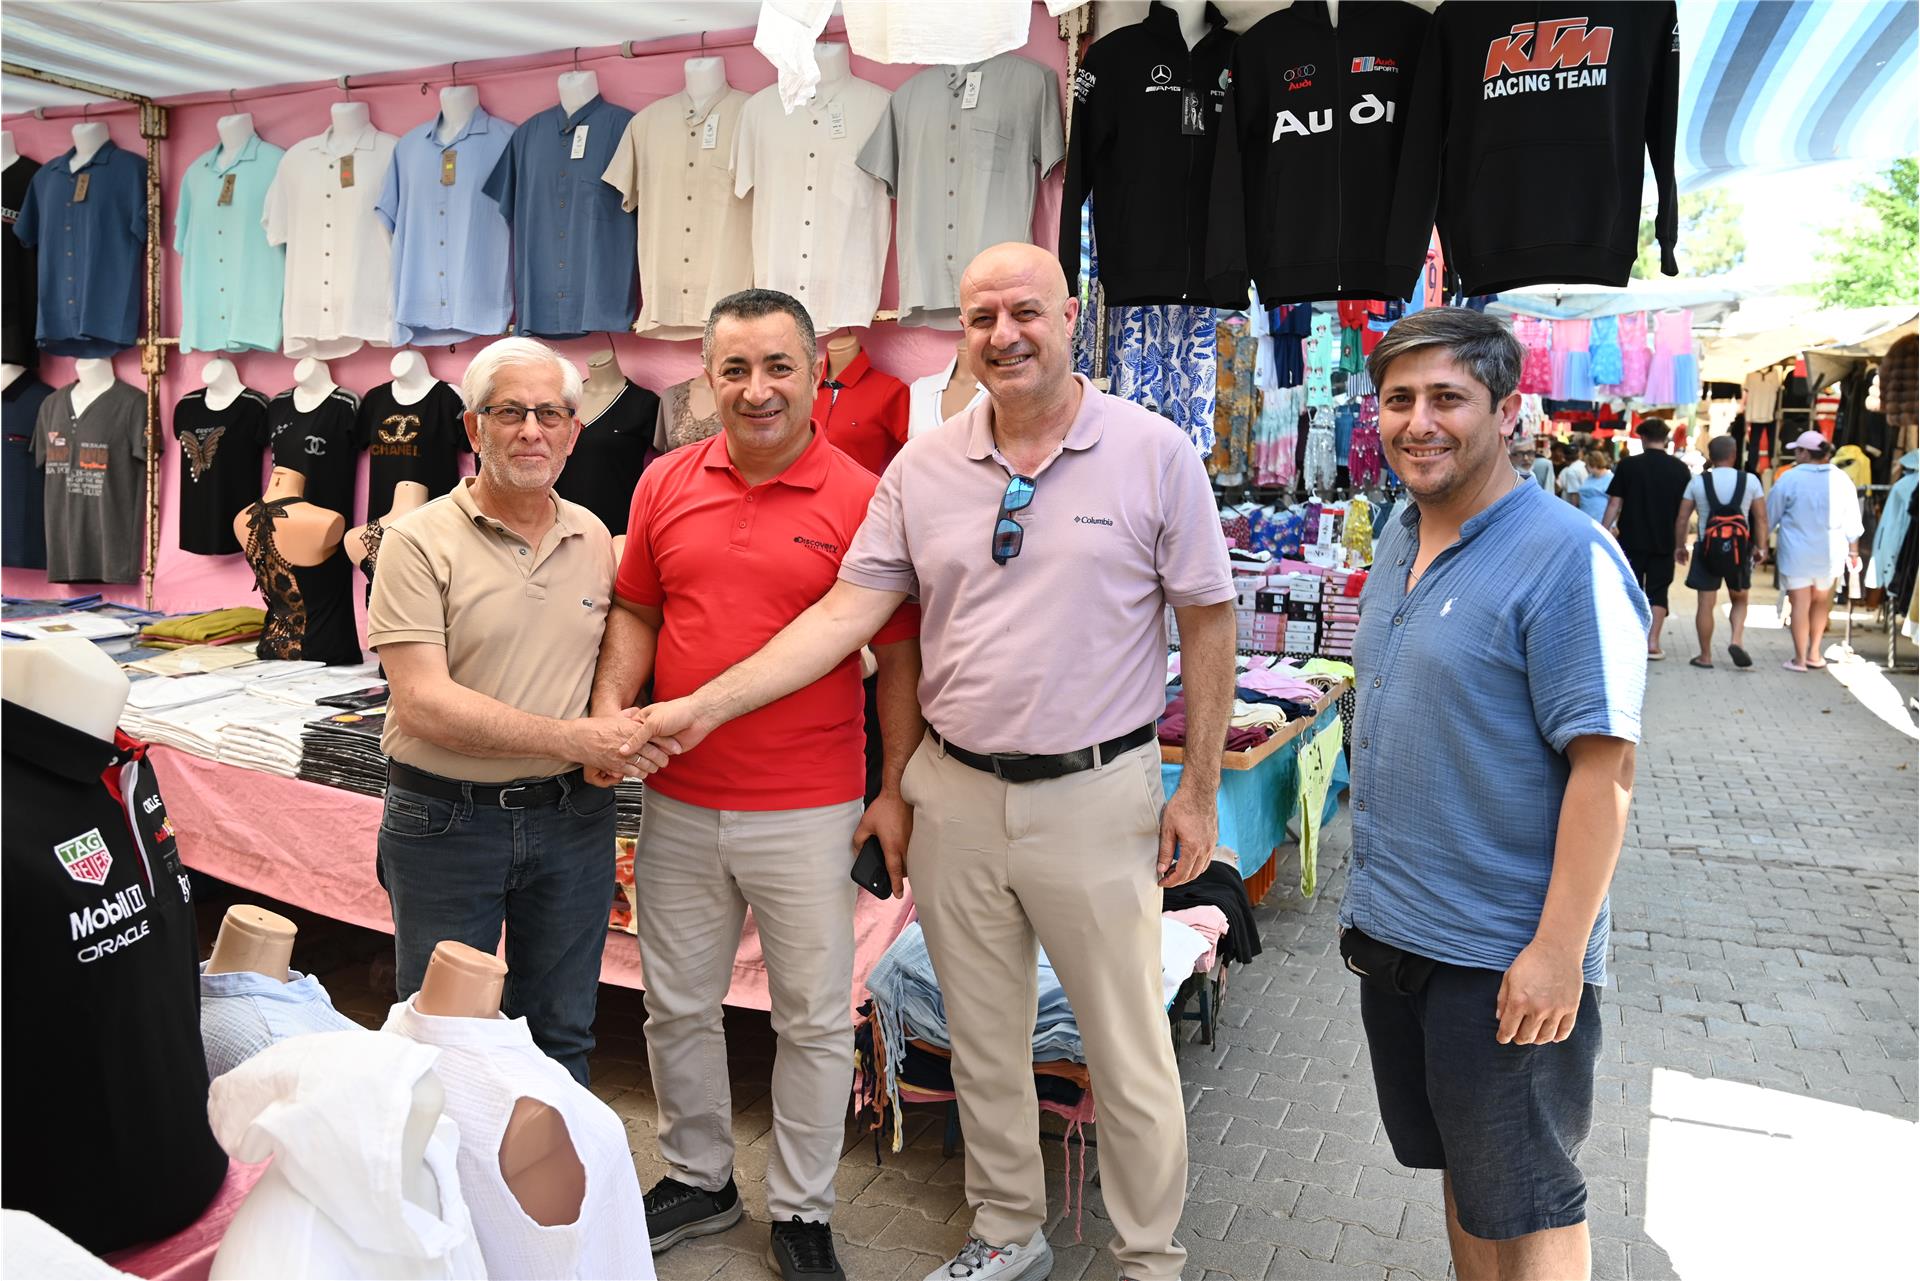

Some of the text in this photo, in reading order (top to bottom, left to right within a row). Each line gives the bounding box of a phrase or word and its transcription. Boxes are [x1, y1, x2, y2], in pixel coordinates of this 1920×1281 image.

[1375, 58, 1396, 66] Audi
[1484, 17, 1613, 82] KTM
[1288, 79, 1312, 91] Audi
[1484, 68, 1607, 100] RACING TEAM
[1081, 516, 1113, 527] Columbia
[60, 834, 101, 862] TAG
[69, 850, 110, 880] HEUER
[69, 890, 133, 941] Mobil
[77, 919, 151, 963] ORACLE
